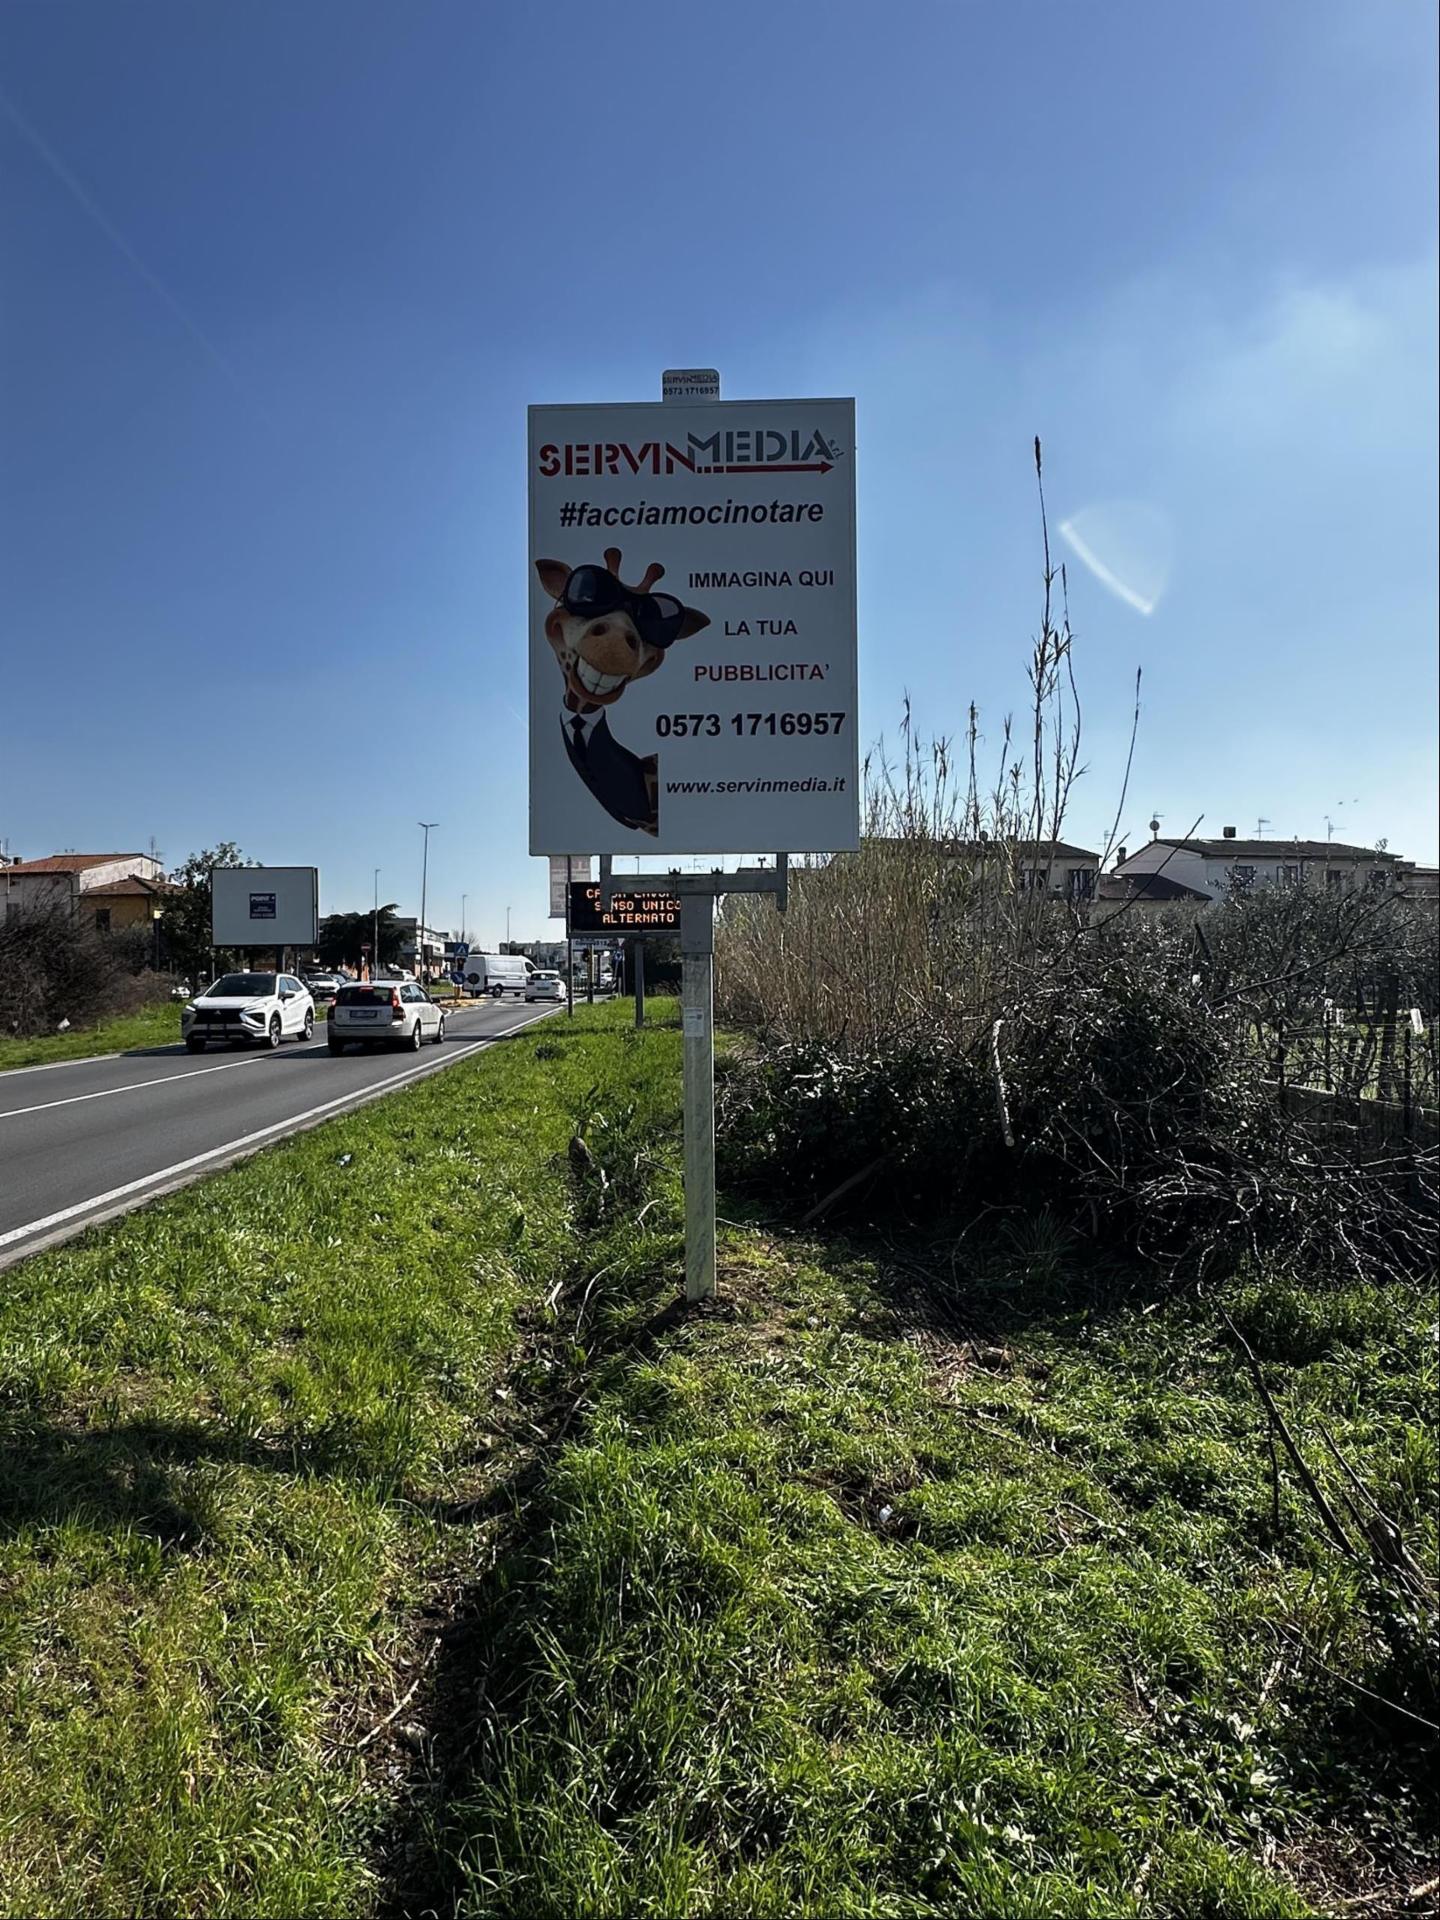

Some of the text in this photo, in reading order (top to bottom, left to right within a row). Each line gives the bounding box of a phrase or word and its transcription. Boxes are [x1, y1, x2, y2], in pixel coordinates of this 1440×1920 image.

[539, 429, 834, 477] SERVINMEDIA
[560, 499, 824, 527] #facciamocinotare
[688, 570, 834, 589] IMMAGINA QUI
[724, 620, 798, 636] LA TUA
[655, 712, 846, 737] 0573 1716957
[666, 777, 846, 794] www.servinmedia.it
[594, 901, 634, 911] SNSO
[602, 913, 675, 923] ALTERNATO
